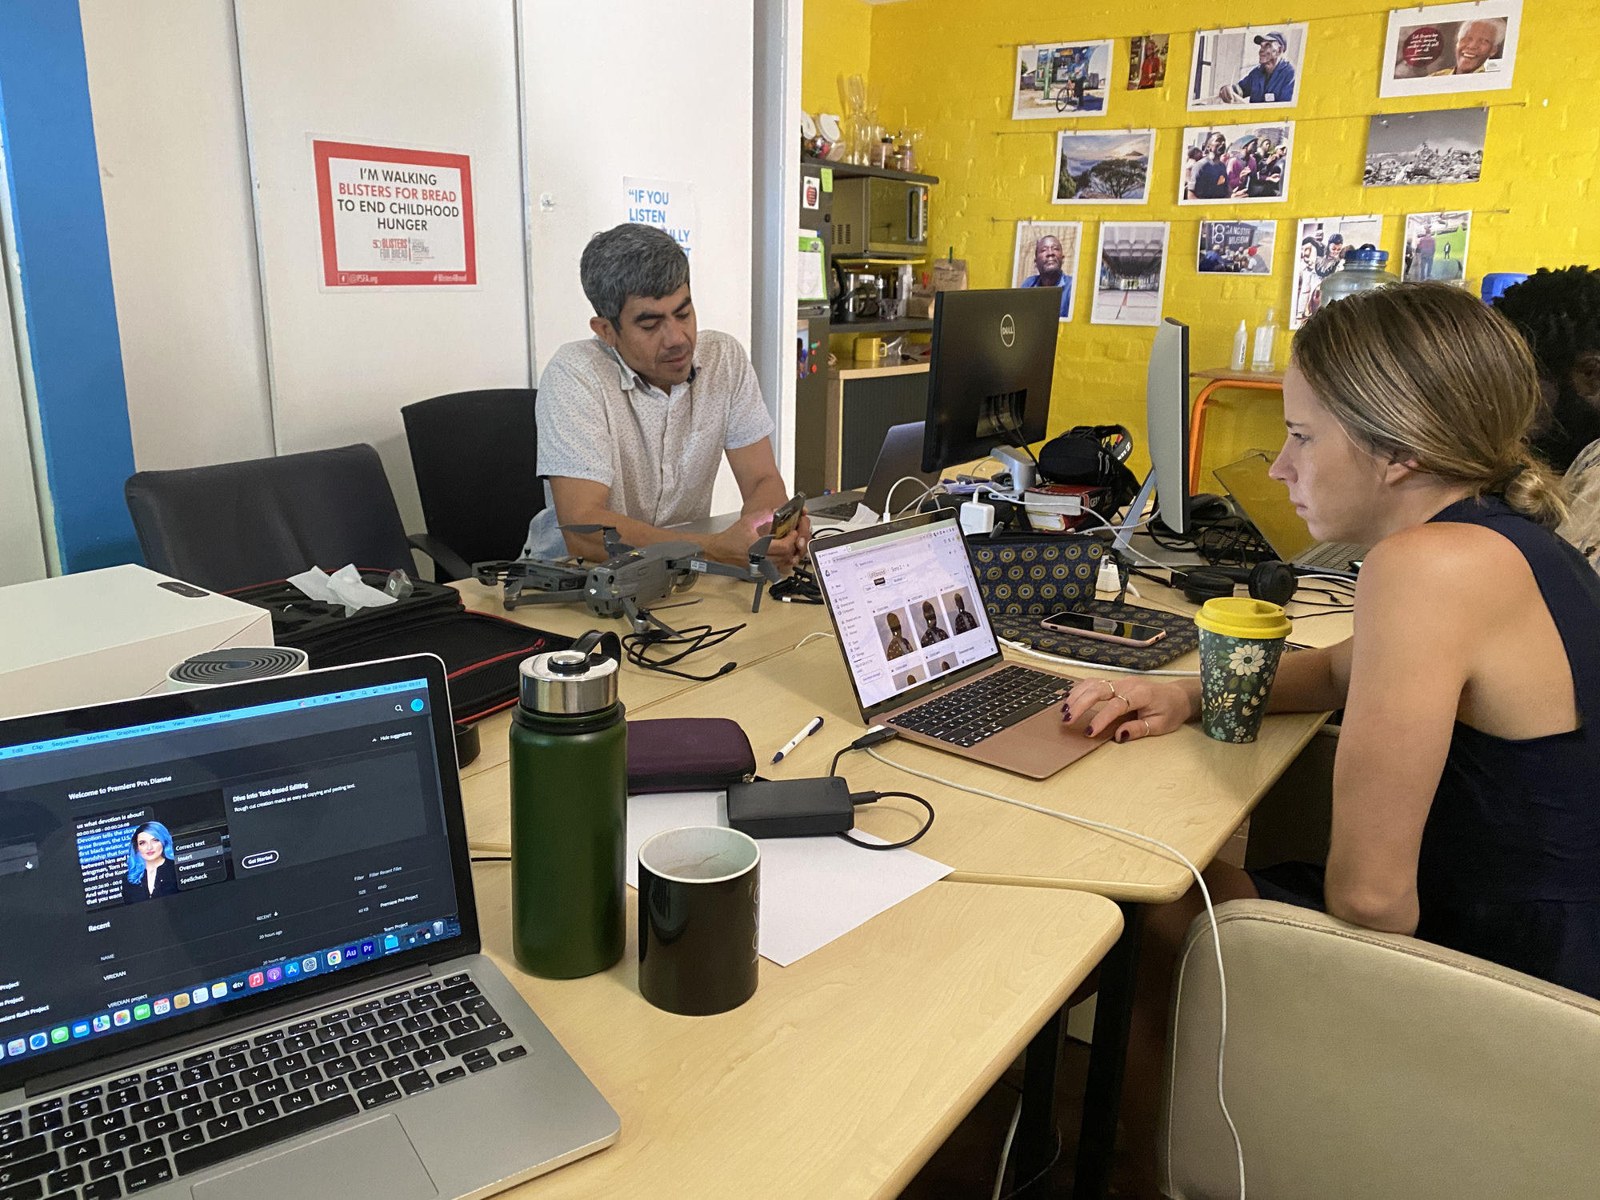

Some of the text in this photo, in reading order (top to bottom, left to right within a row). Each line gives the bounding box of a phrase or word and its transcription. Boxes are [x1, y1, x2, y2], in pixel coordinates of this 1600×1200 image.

[360, 168, 437, 186] I'M WALKING
[338, 182, 456, 202] BLISTERS FOR BREAD
[646, 190, 669, 205] YOU
[337, 199, 459, 218] TO END CHILDHOOD
[629, 208, 666, 222] LISTEN
[378, 218, 428, 231] HUNGER
[381, 238, 408, 248] BLISTERS
[68, 790, 98, 800] Welcome
[108, 783, 136, 793] Premiere
[150, 776, 172, 785] Dianne
[98, 816, 121, 825] devotion
[127, 810, 144, 819] about?
[176, 843, 194, 851] Correct
[81, 862, 104, 870] between
[178, 862, 204, 872] Overwrite
[180, 873, 208, 884] Spellcheck
[86, 890, 96, 898] And
[88, 921, 110, 932] Recent
[346, 950, 356, 958] Au
[103, 970, 126, 980] VIRIDIAN
[4, 996, 24, 1005] Project
[108, 994, 148, 1008] VIRIDIAN project
[30, 1005, 50, 1014] Project
[156, 1004, 168, 1013] 28
